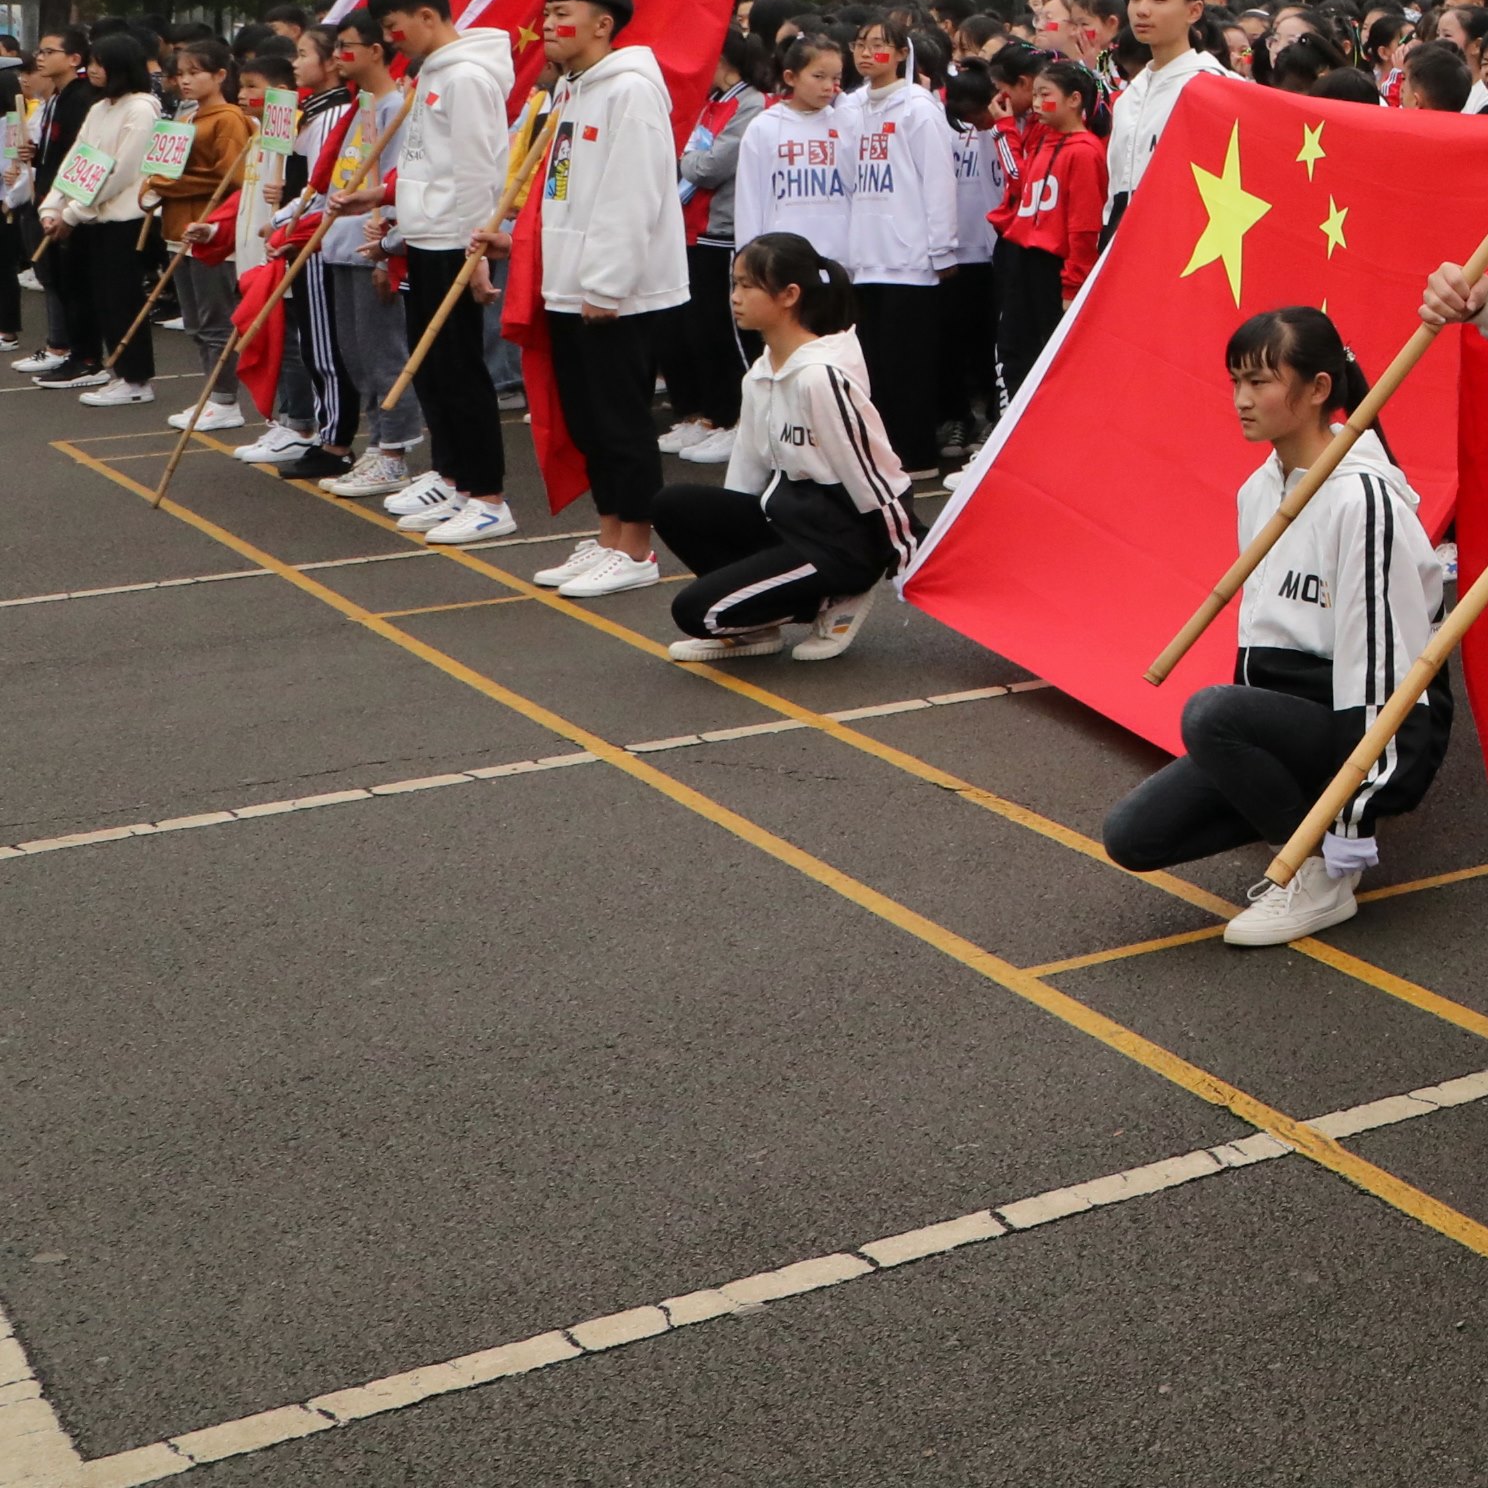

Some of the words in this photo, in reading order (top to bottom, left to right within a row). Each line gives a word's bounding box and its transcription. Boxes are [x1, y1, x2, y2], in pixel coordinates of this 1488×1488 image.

[146, 133, 188, 165] 292班
[63, 155, 106, 193] 294班
[772, 168, 844, 200] CHINA
